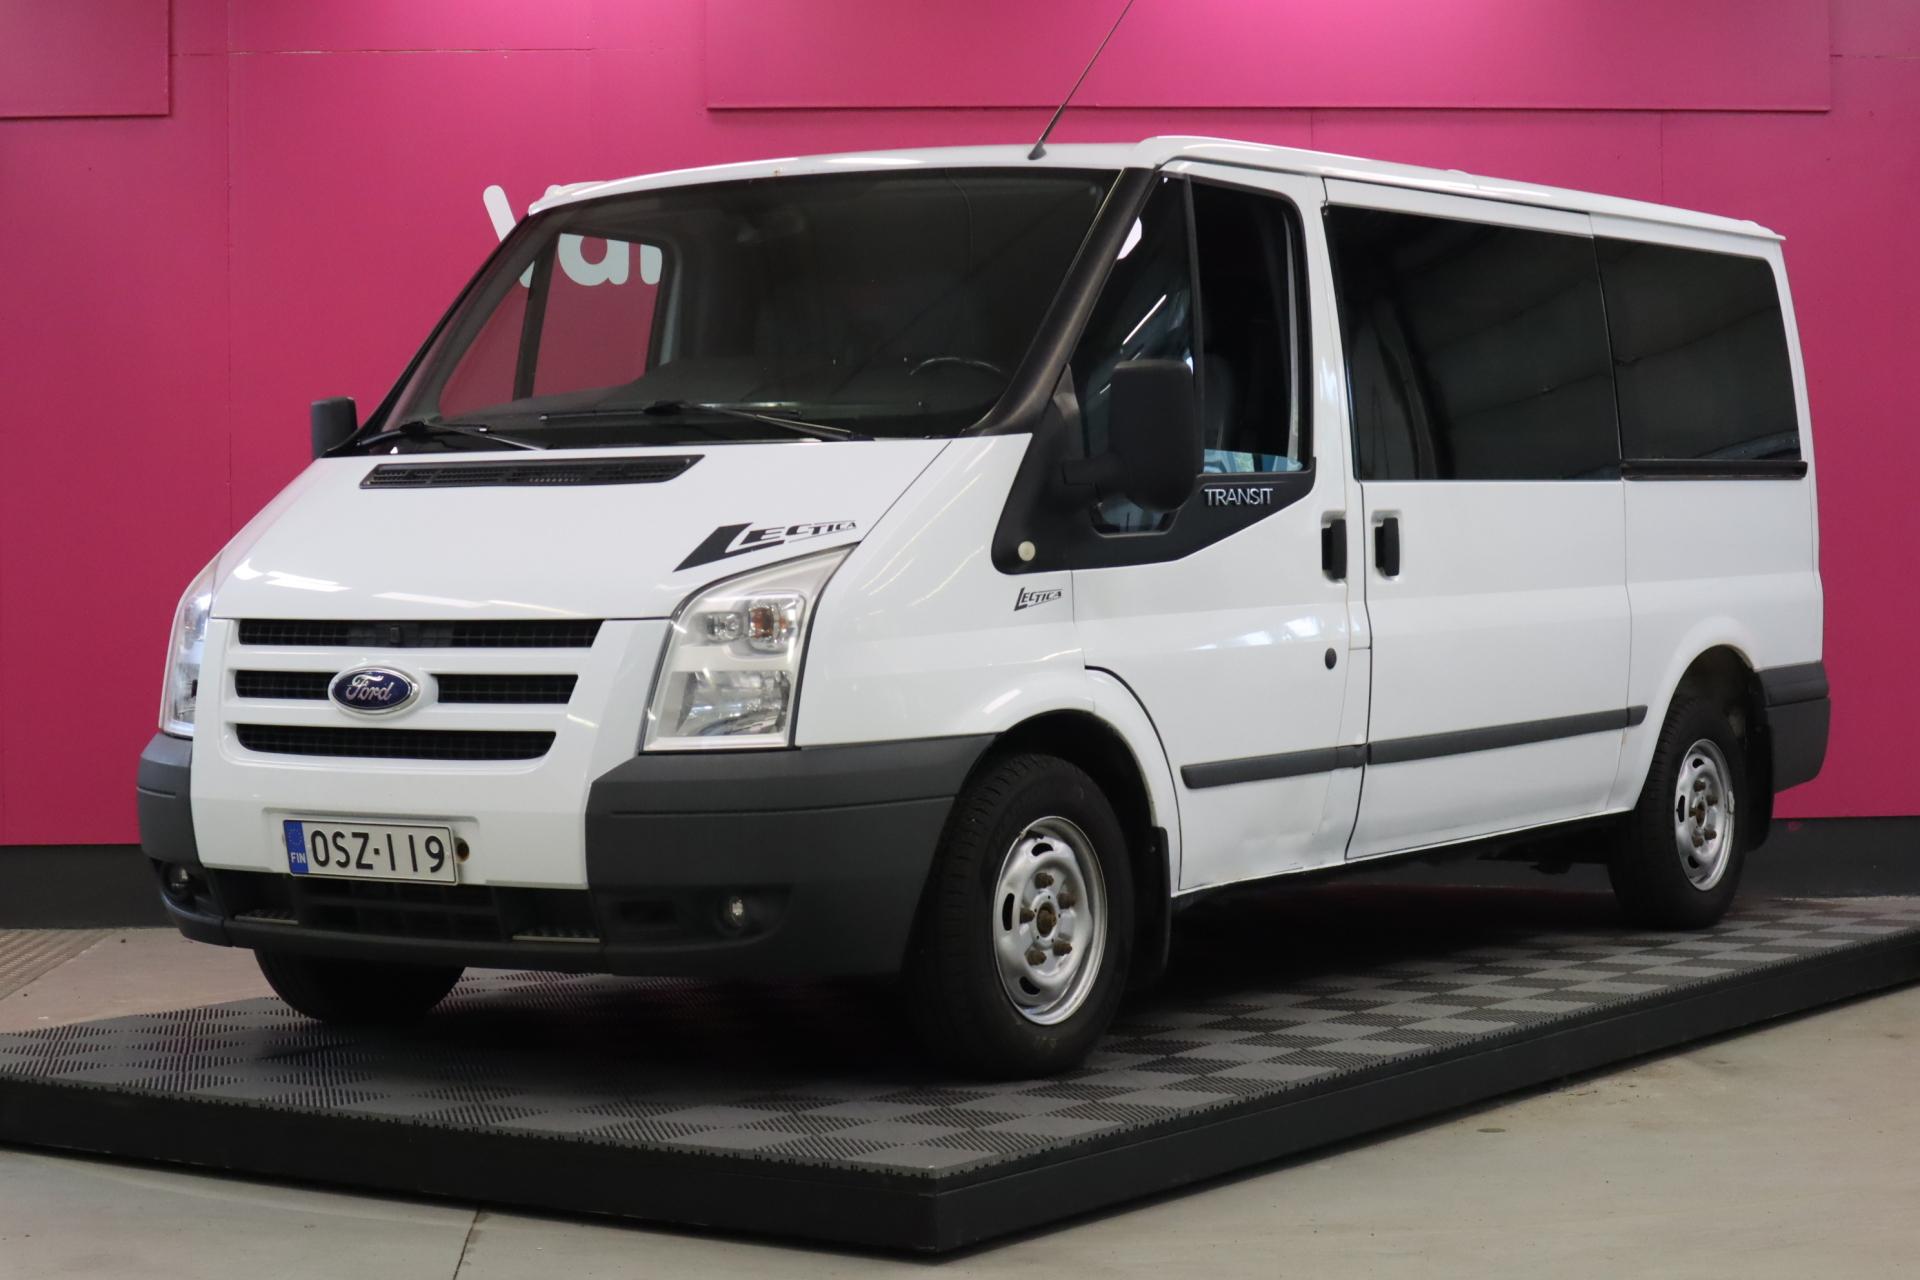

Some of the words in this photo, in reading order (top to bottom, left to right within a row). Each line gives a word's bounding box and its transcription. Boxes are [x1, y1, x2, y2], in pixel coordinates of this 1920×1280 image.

[1204, 487, 1273, 506] TRANSIT
[345, 674, 396, 701] Ford
[290, 852, 306, 864] FIN
[310, 829, 445, 874] OSZ-119
